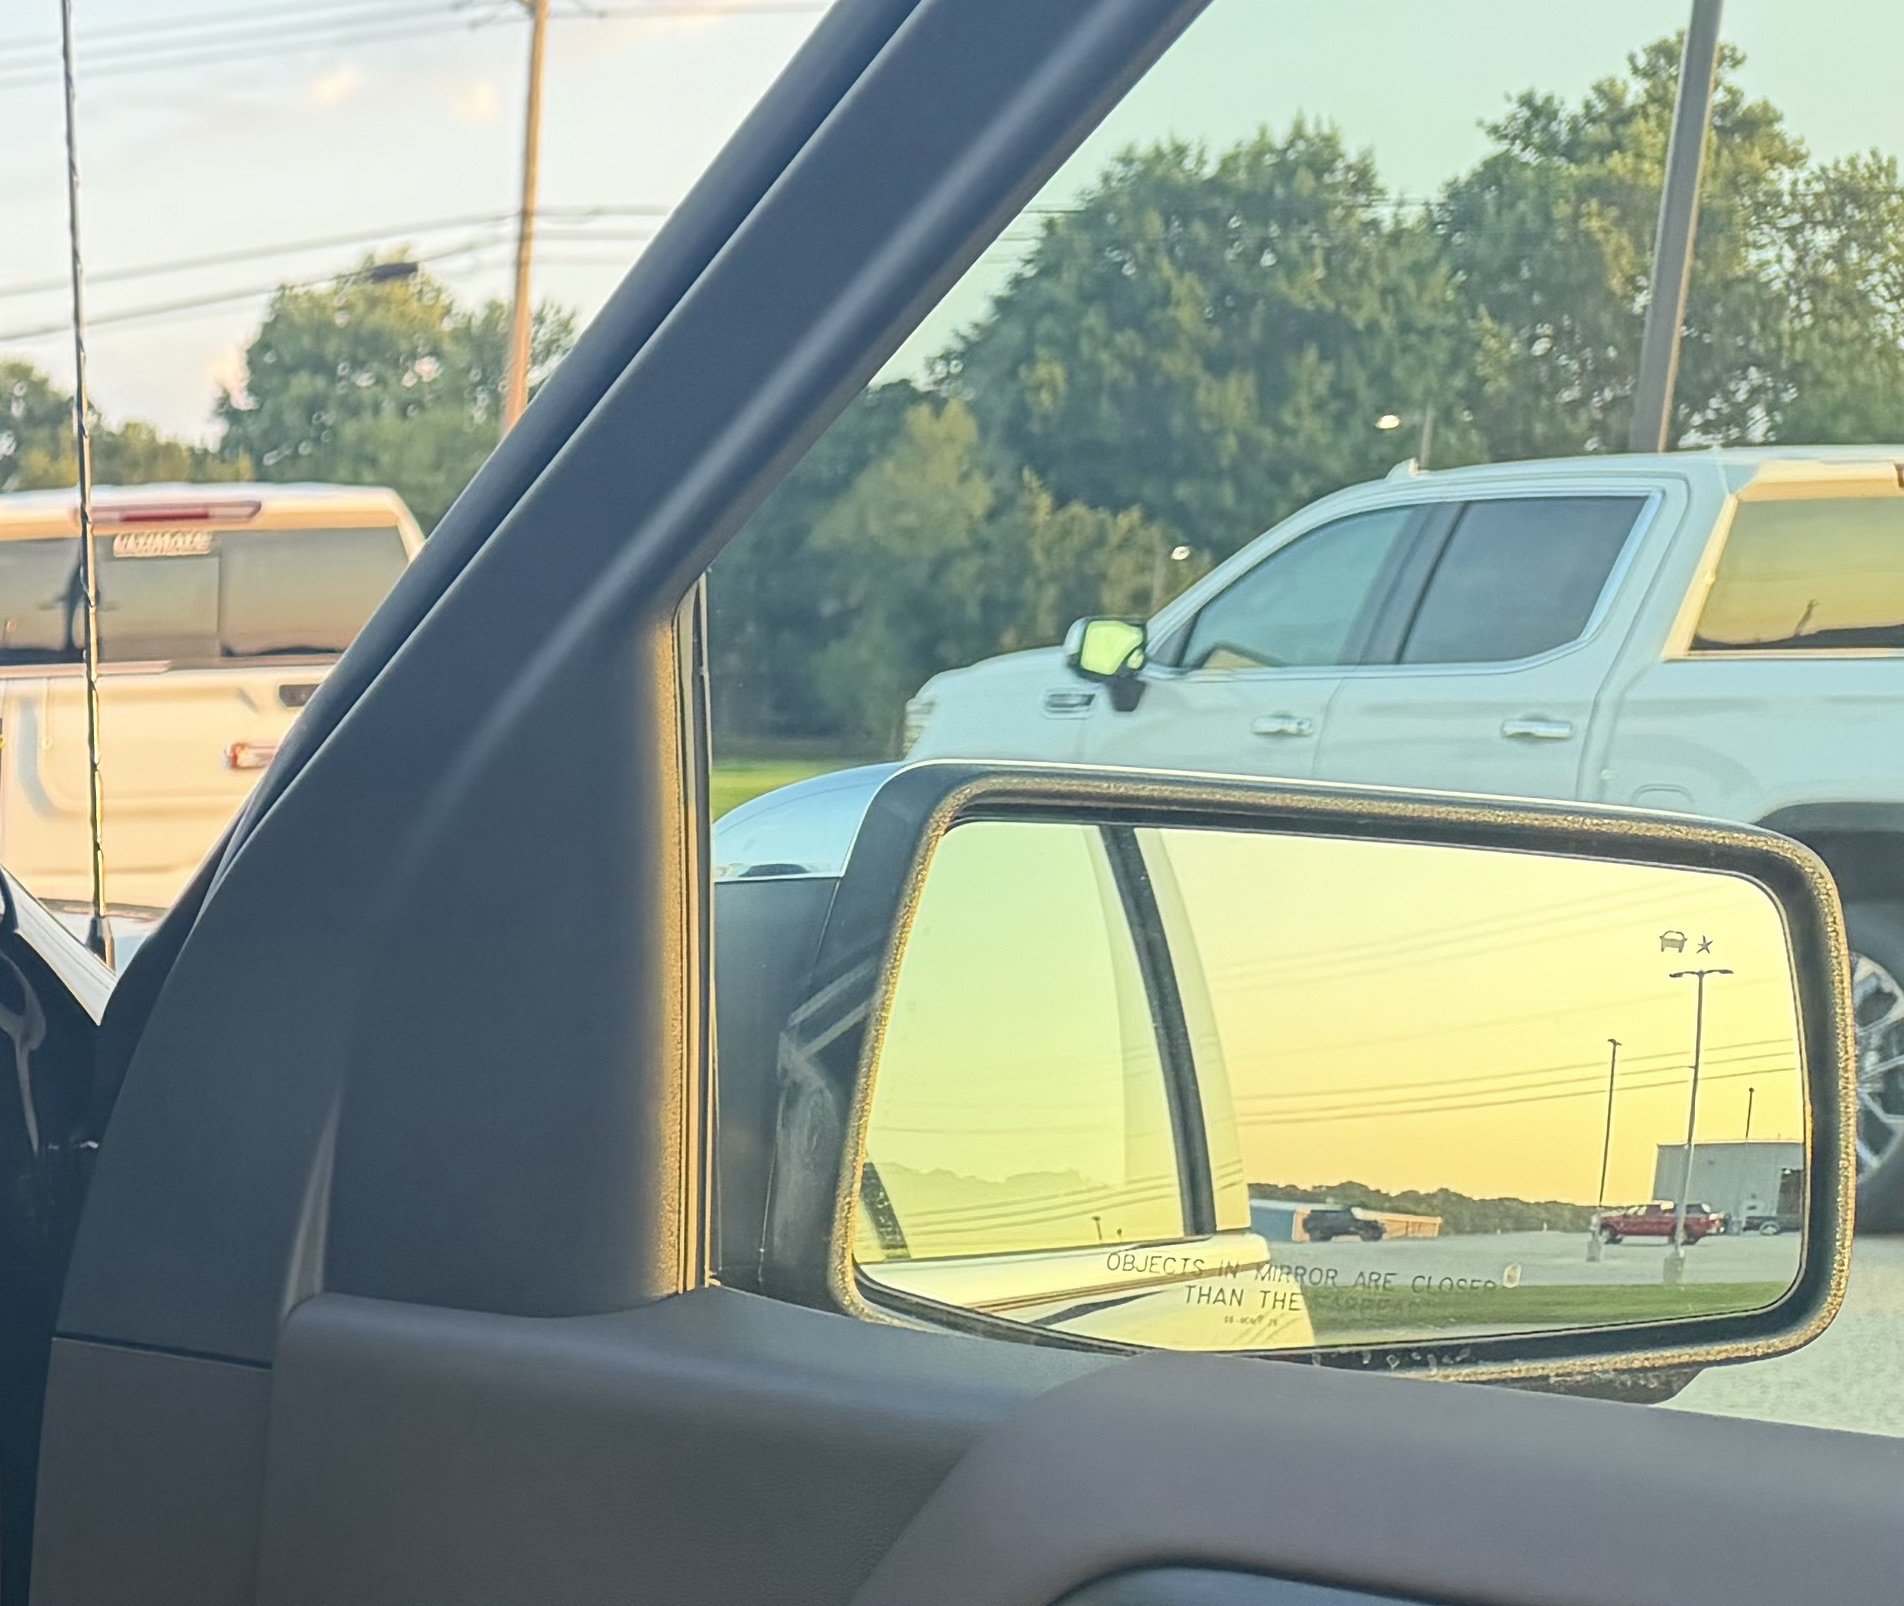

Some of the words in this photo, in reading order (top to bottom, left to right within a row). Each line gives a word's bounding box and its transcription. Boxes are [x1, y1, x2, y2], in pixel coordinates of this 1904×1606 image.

[1106, 1251, 1206, 1277] OBJECTS
[1217, 1259, 1241, 1280] IN
[1254, 1262, 1339, 1288] MIRROR
[1352, 1271, 1399, 1291] ARE
[1185, 1285, 1244, 1308] THAN
